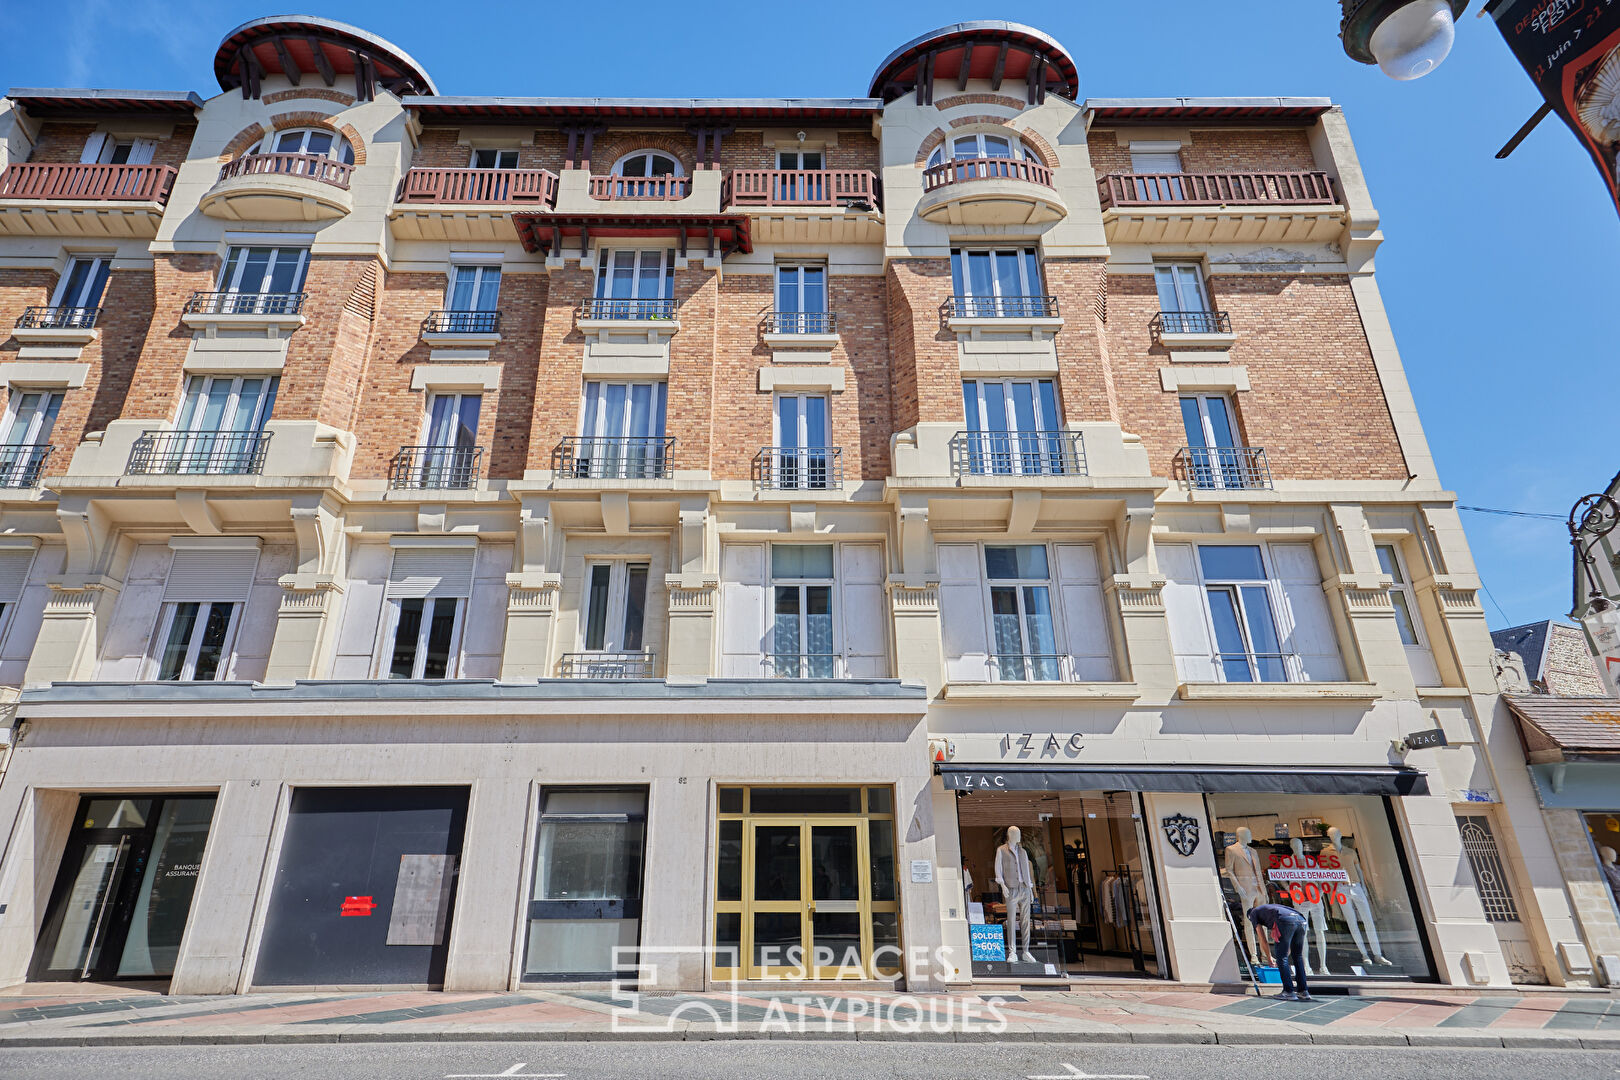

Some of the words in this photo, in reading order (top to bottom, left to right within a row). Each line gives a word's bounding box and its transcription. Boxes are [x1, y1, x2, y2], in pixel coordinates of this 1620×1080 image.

[1547, 40, 1571, 69] juin
[1585, 6, 1602, 28] 21
[1006, 732, 1085, 750] IZAC
[1412, 734, 1437, 745] IZAC
[954, 775, 1005, 787] IZAC
[1268, 854, 1341, 869] SOLDES
[1270, 871, 1306, 879] NOUVELLE
[1307, 871, 1347, 879] DEMARQUE
[1275, 882, 1347, 905] -60%
[972, 932, 1003, 940] SOLDES
